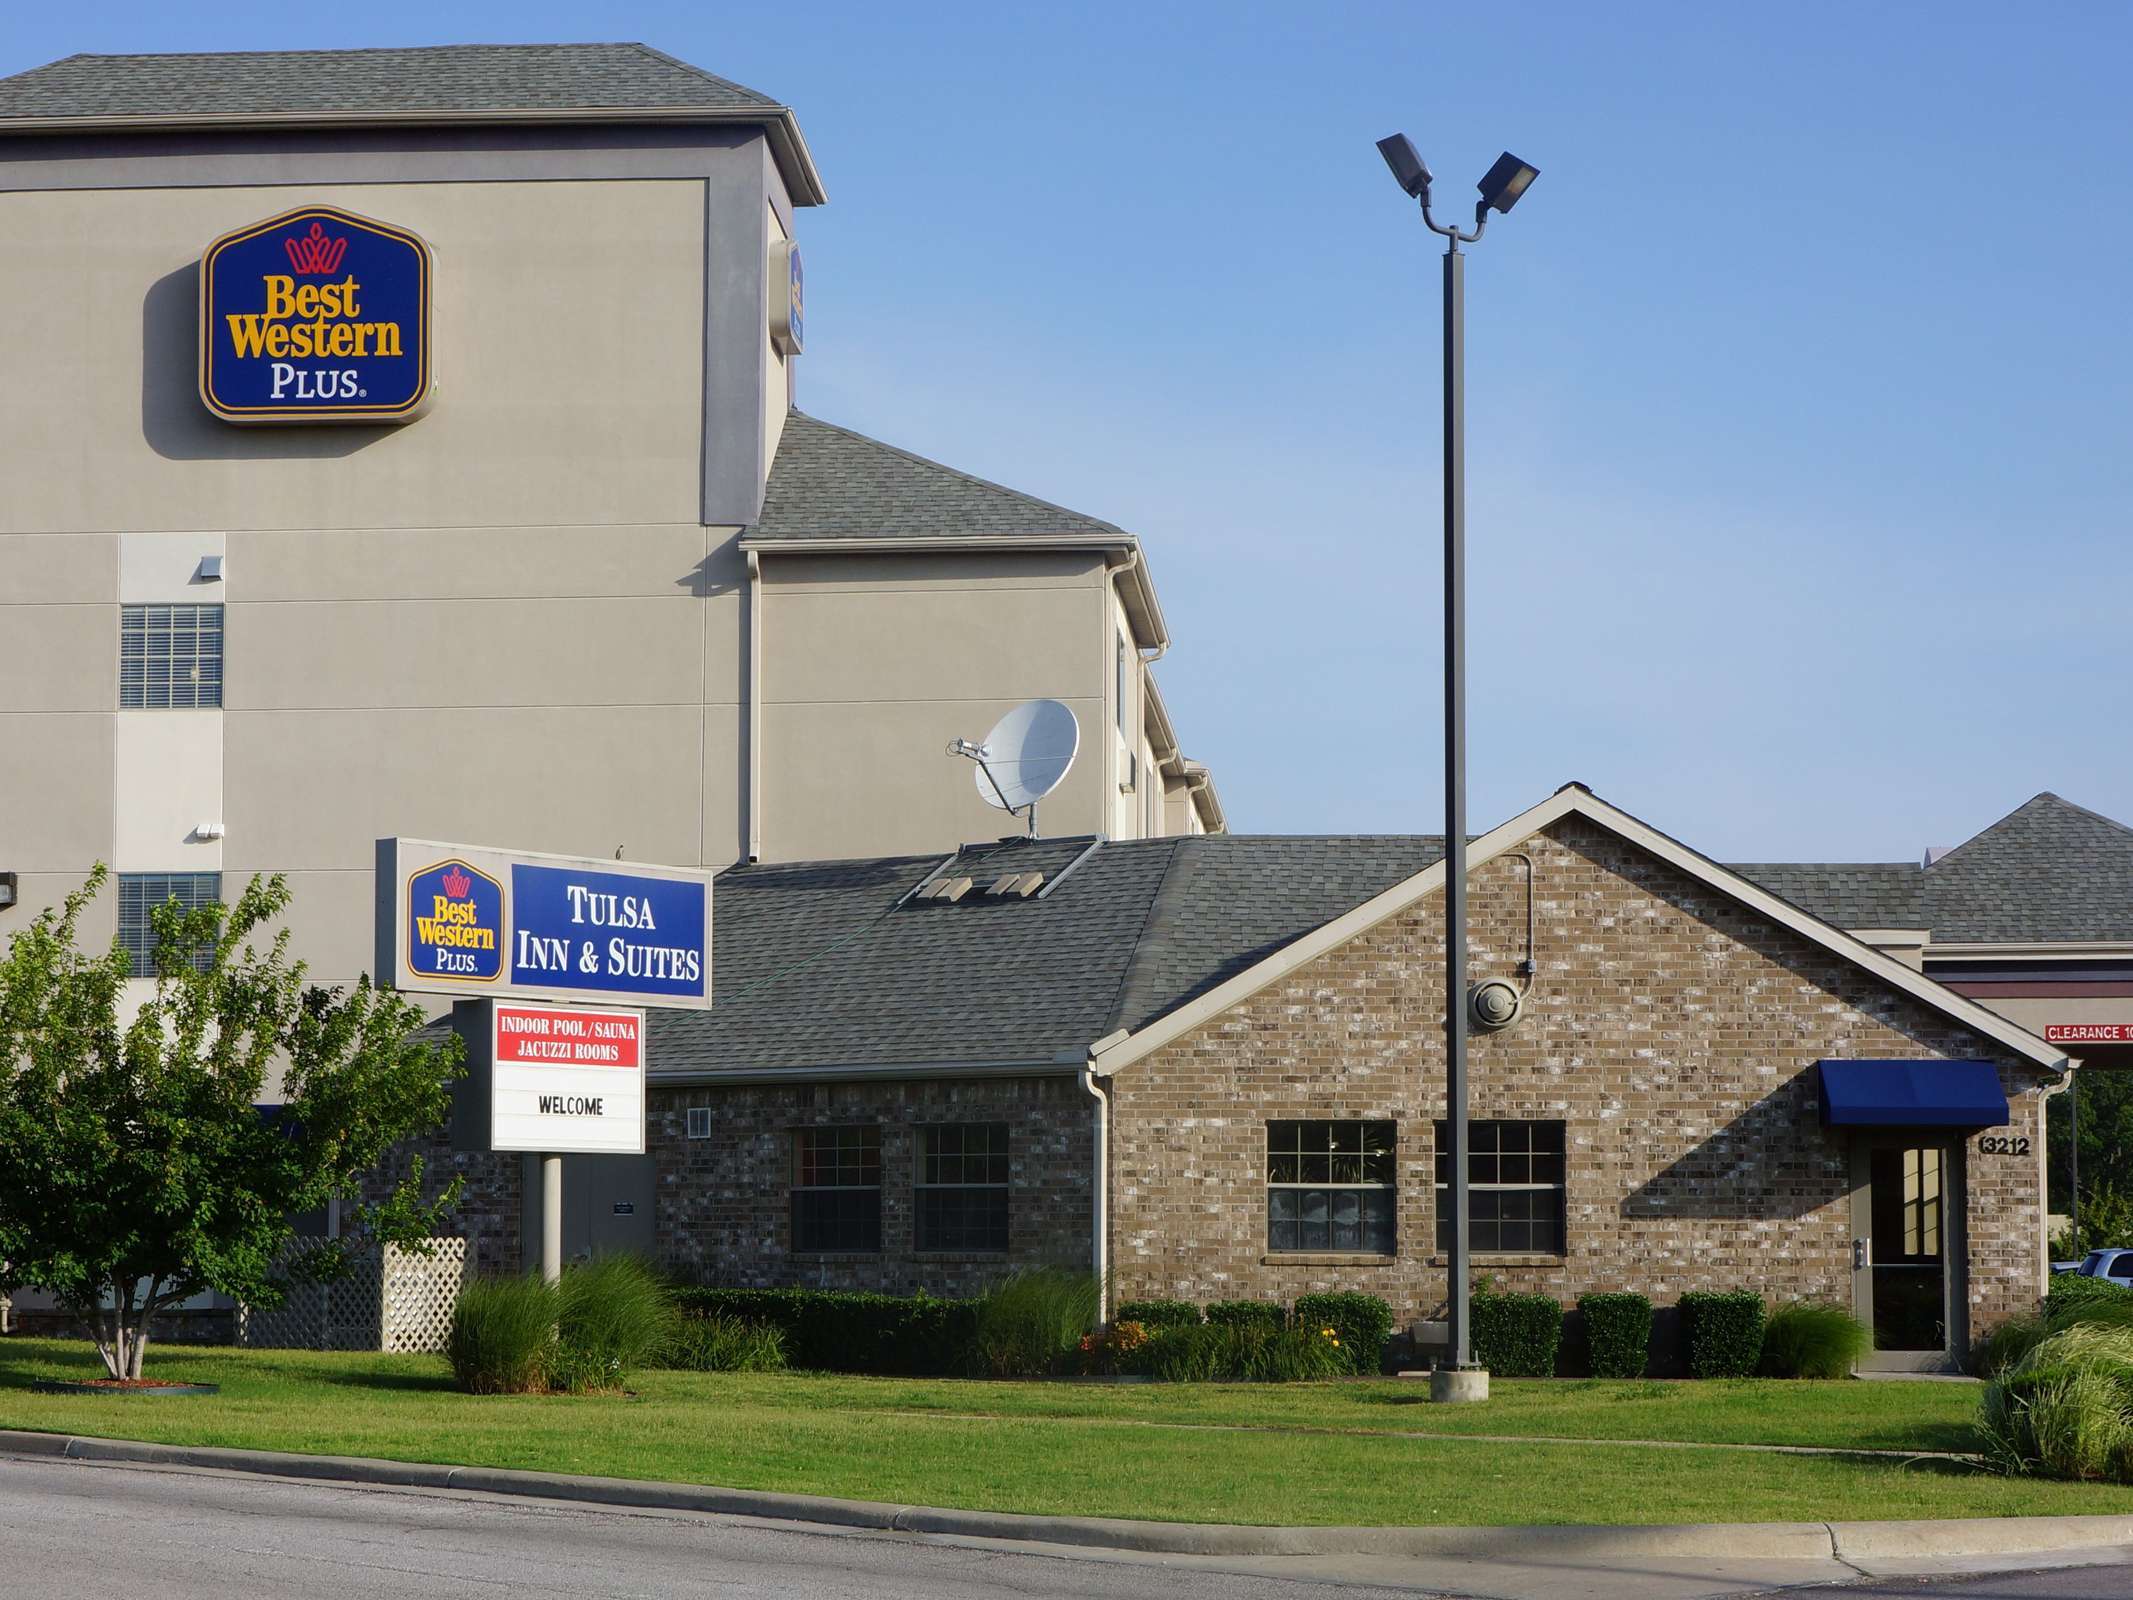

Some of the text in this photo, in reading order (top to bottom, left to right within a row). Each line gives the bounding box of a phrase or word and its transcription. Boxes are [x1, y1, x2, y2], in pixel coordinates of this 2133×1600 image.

[263, 275, 361, 319] Best
[226, 308, 404, 358] Western
[433, 895, 477, 925] Best
[567, 885, 657, 930] TULSA
[416, 917, 495, 950] Western
[516, 930, 700, 982] INN & SUITES
[501, 1016, 550, 1035] INDOOR
[2048, 1026, 2120, 1040] CLEARANCE
[518, 1040, 619, 1061] JACUZZI ROOMS
[538, 1095, 604, 1116] WELCOME
